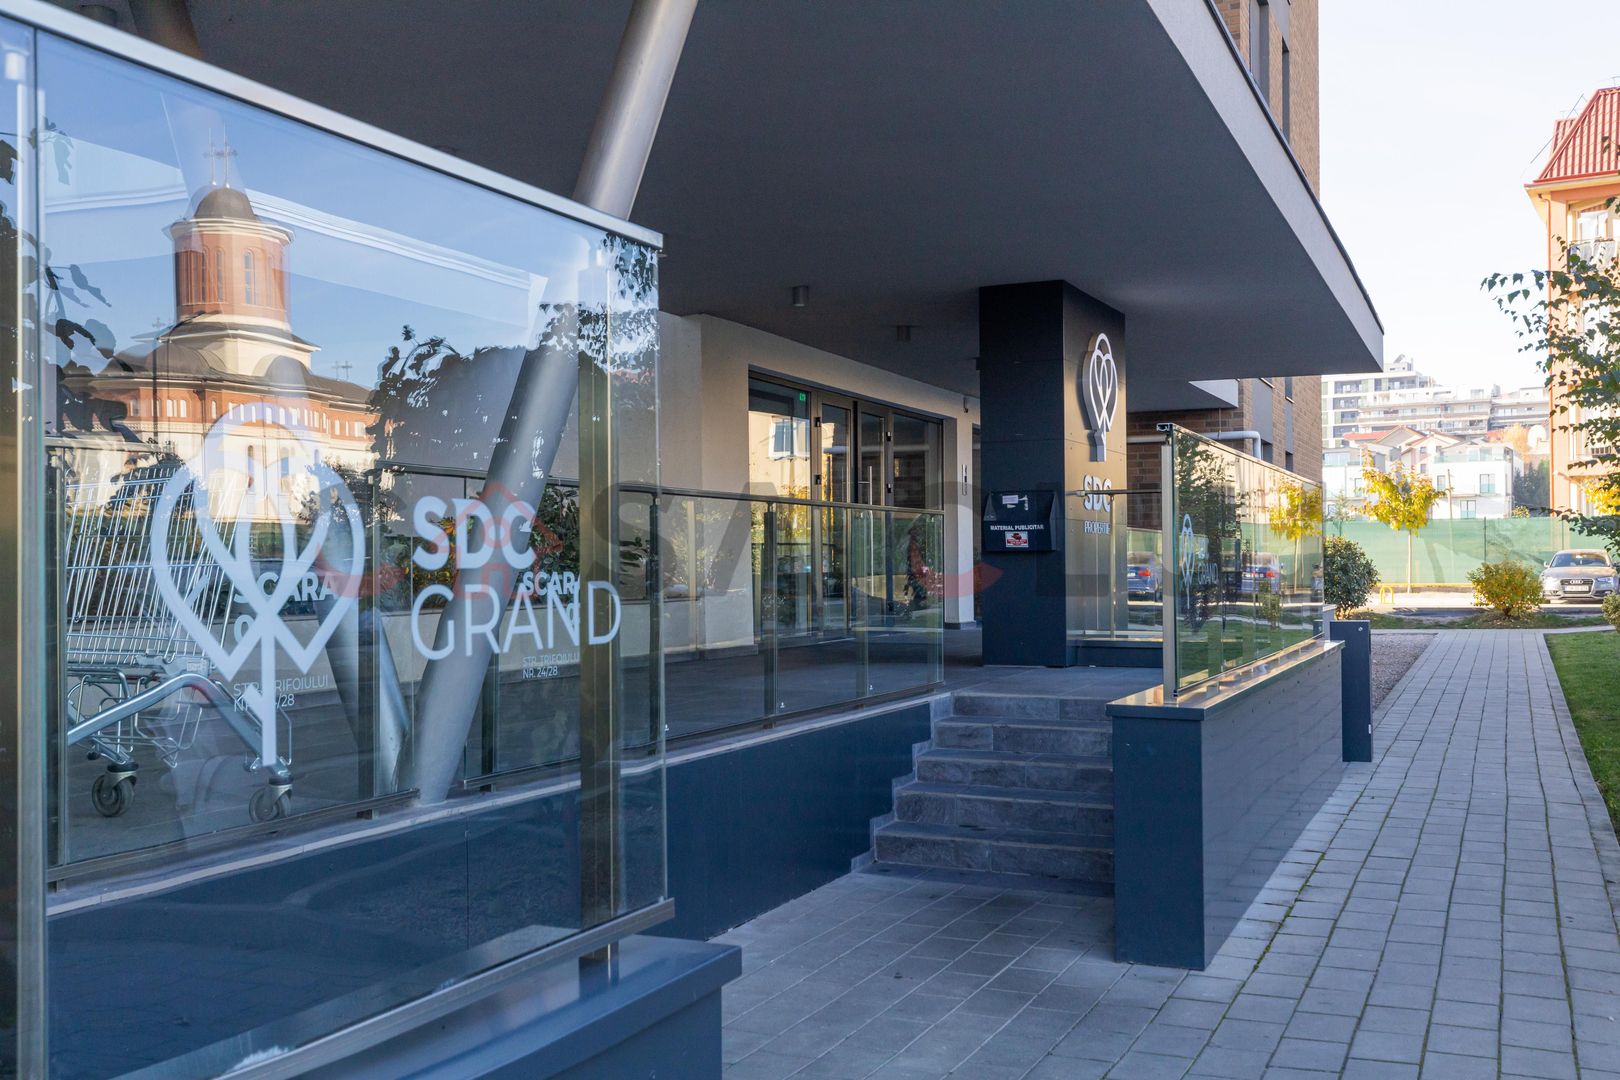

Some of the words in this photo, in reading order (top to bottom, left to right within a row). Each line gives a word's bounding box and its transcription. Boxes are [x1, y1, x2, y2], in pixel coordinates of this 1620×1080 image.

[1084, 475, 1112, 512] SDC
[412, 496, 537, 570] SDC
[234, 571, 338, 603] CARA
[523, 571, 580, 596] SCAR
[411, 581, 621, 660] GRAND
[275, 674, 329, 692] RIFOIULUI
[537, 666, 558, 678] 24/28
